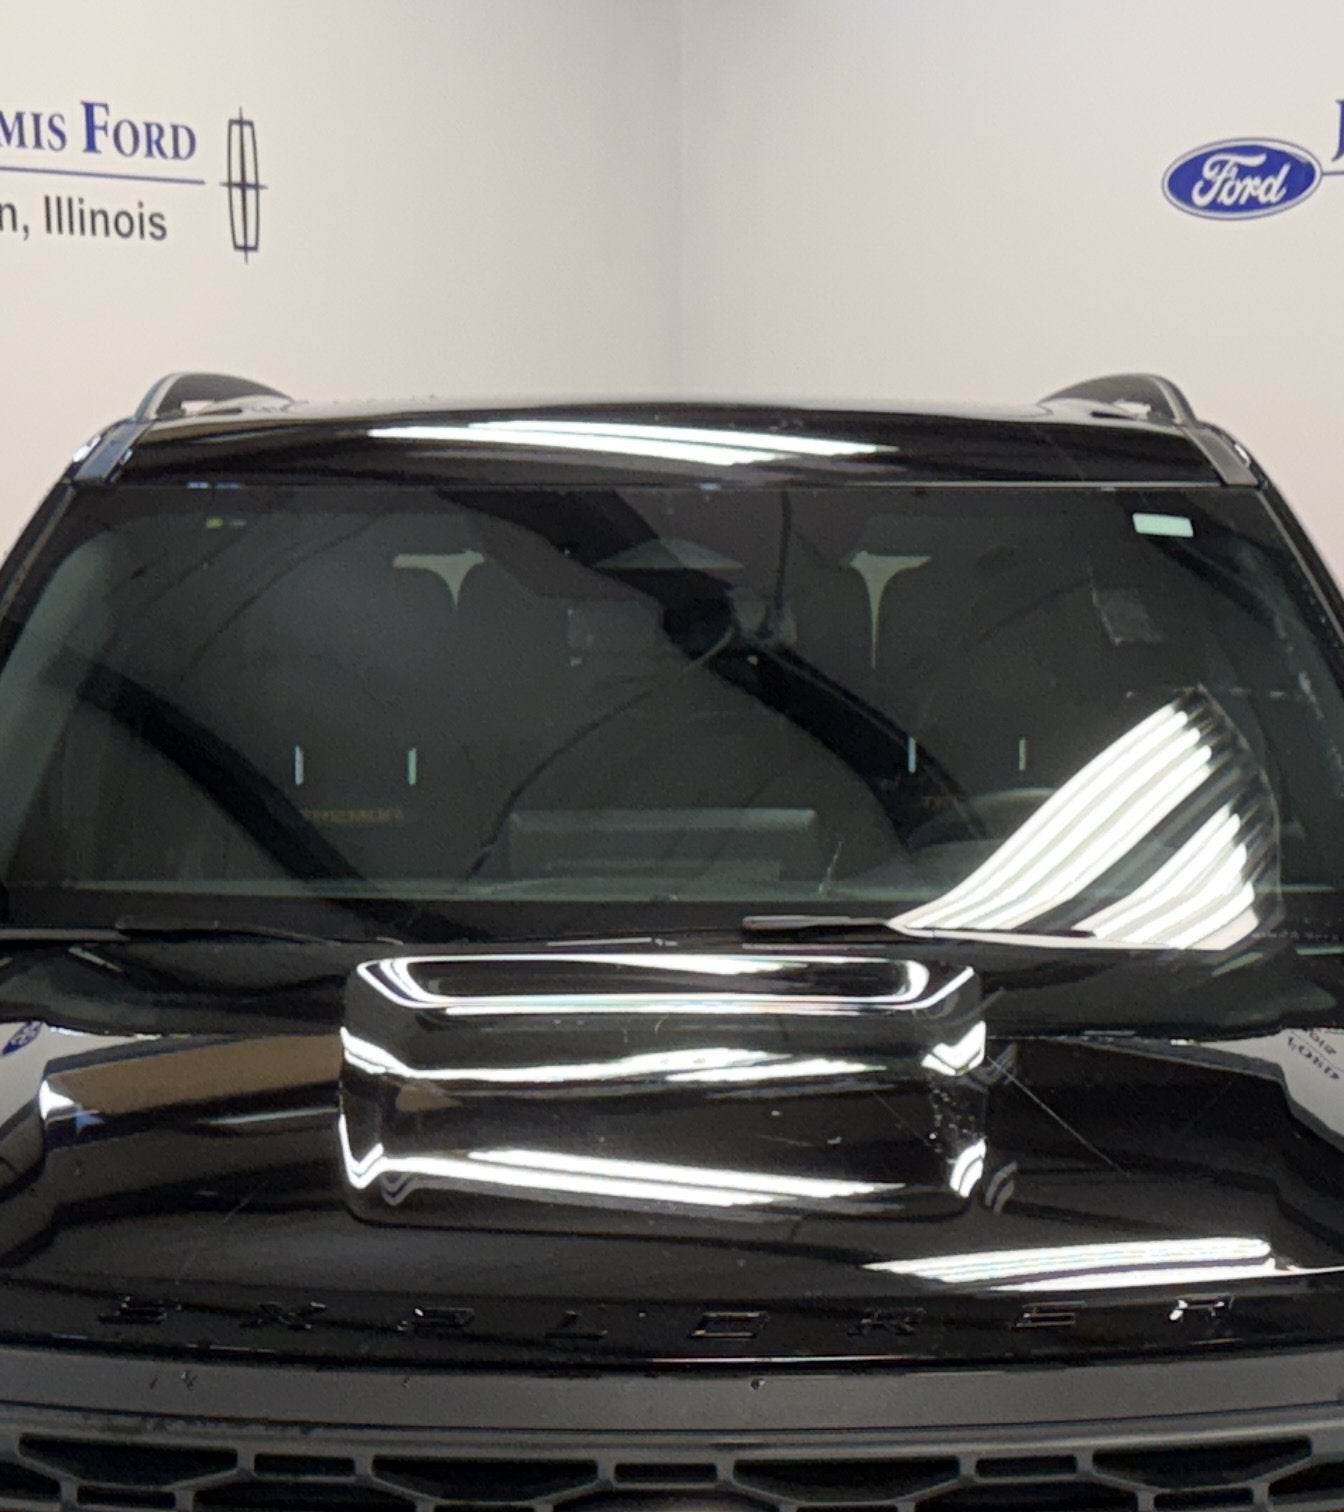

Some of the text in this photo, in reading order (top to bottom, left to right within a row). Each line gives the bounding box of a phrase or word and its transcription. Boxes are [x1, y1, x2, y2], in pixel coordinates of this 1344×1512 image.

[81, 101, 196, 160] FORD
[1191, 153, 1289, 207] Ford
[44, 195, 167, 241] Illinois
